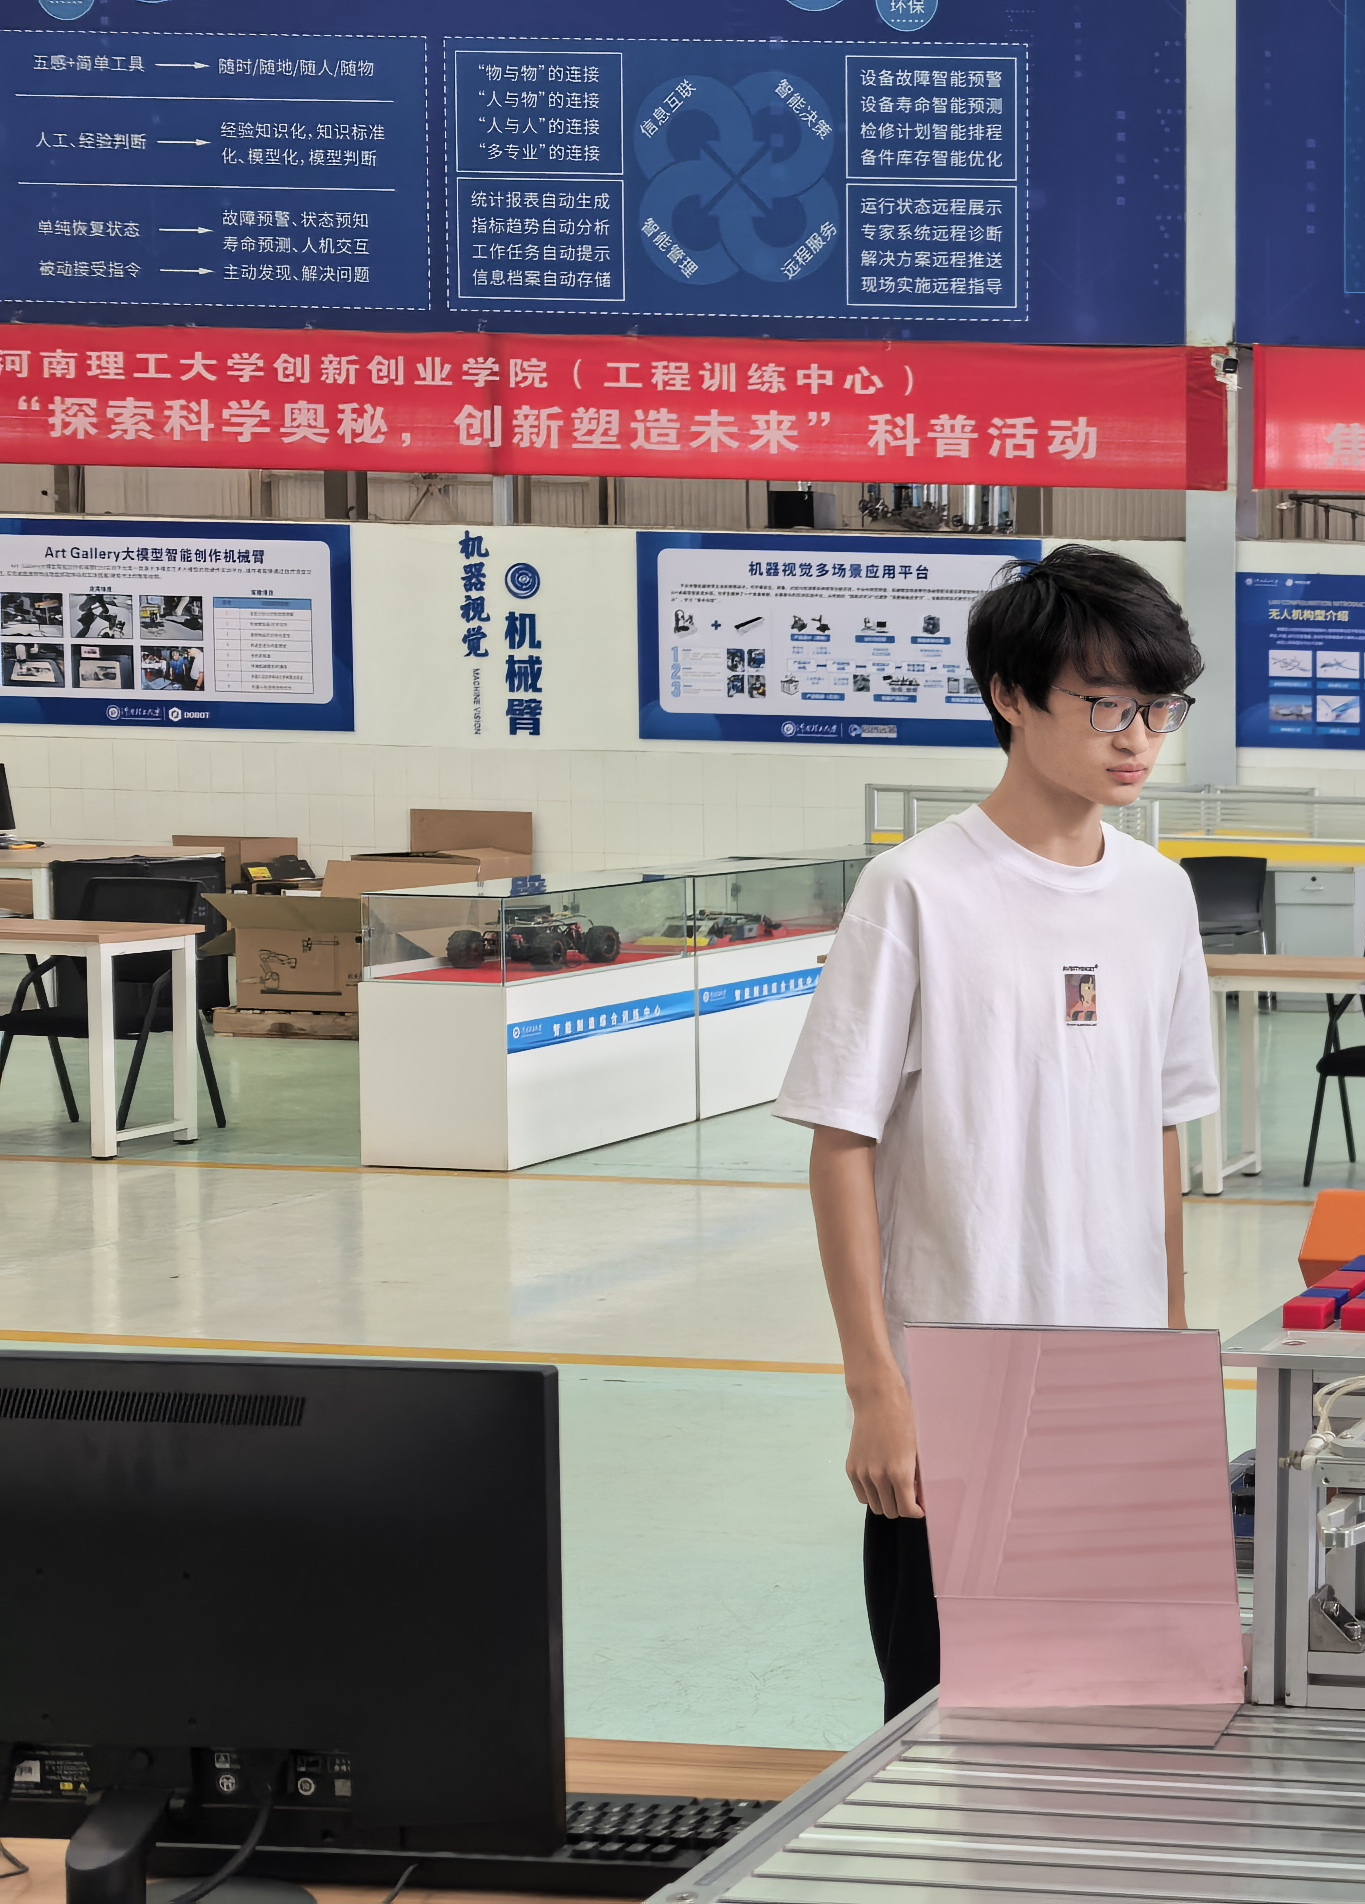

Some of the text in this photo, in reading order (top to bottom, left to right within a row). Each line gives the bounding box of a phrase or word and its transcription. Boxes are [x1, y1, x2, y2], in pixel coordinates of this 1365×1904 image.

[34, 55, 144, 71] 五感+简单工具
[219, 59, 373, 76] 随时/随地/随人/随物
[479, 64, 599, 82] “物与物”的连接
[860, 70, 1002, 87] 设备故障智能预警
[479, 91, 599, 108] “人与物”的连接
[861, 96, 1002, 114] 设备寿命智能预测
[640, 80, 696, 137] 信息互联
[775, 79, 832, 139] 智能决策
[479, 117, 599, 135] “人与人”的连接
[861, 122, 1002, 140] 检修计划智能排程
[36, 132, 146, 149] 人工、经验判断
[480, 143, 600, 161] “多专业”的连接
[861, 149, 1002, 167] 备件库存智能优化
[471, 191, 610, 209] 统计报表自动生成
[861, 198, 1002, 215] 运行状态远程展示
[223, 210, 368, 228] 故障预警、状态预知
[472, 217, 610, 235] 指标趋势自动分析
[38, 220, 140, 237] 单纯恢复状态
[861, 224, 1002, 241] 专家系统远程诊断
[223, 237, 369, 254] 寿命预测、人机交互
[473, 244, 610, 261] 工作任务自动提示
[641, 218, 698, 278] 智能管理
[781, 222, 836, 279] 远程服务
[861, 250, 1002, 268] 解决方案远程推送
[39, 260, 141, 277] 被动接受指令
[224, 264, 369, 282] 主动发现、解决问题
[473, 269, 610, 287] 信息档案自动存储
[861, 277, 1002, 294] 现场实施远程指导
[45, 547, 66, 558] Art
[749, 562, 928, 579] 机器视觉多场景应用平台
[459, 530, 490, 657] 机器视觉
[1268, 609, 1348, 622] 无人机构型介绍
[671, 646, 678, 662] 1
[505, 612, 542, 735] 机械臂
[671, 663, 681, 680] 2
[671, 681, 681, 698] 3
